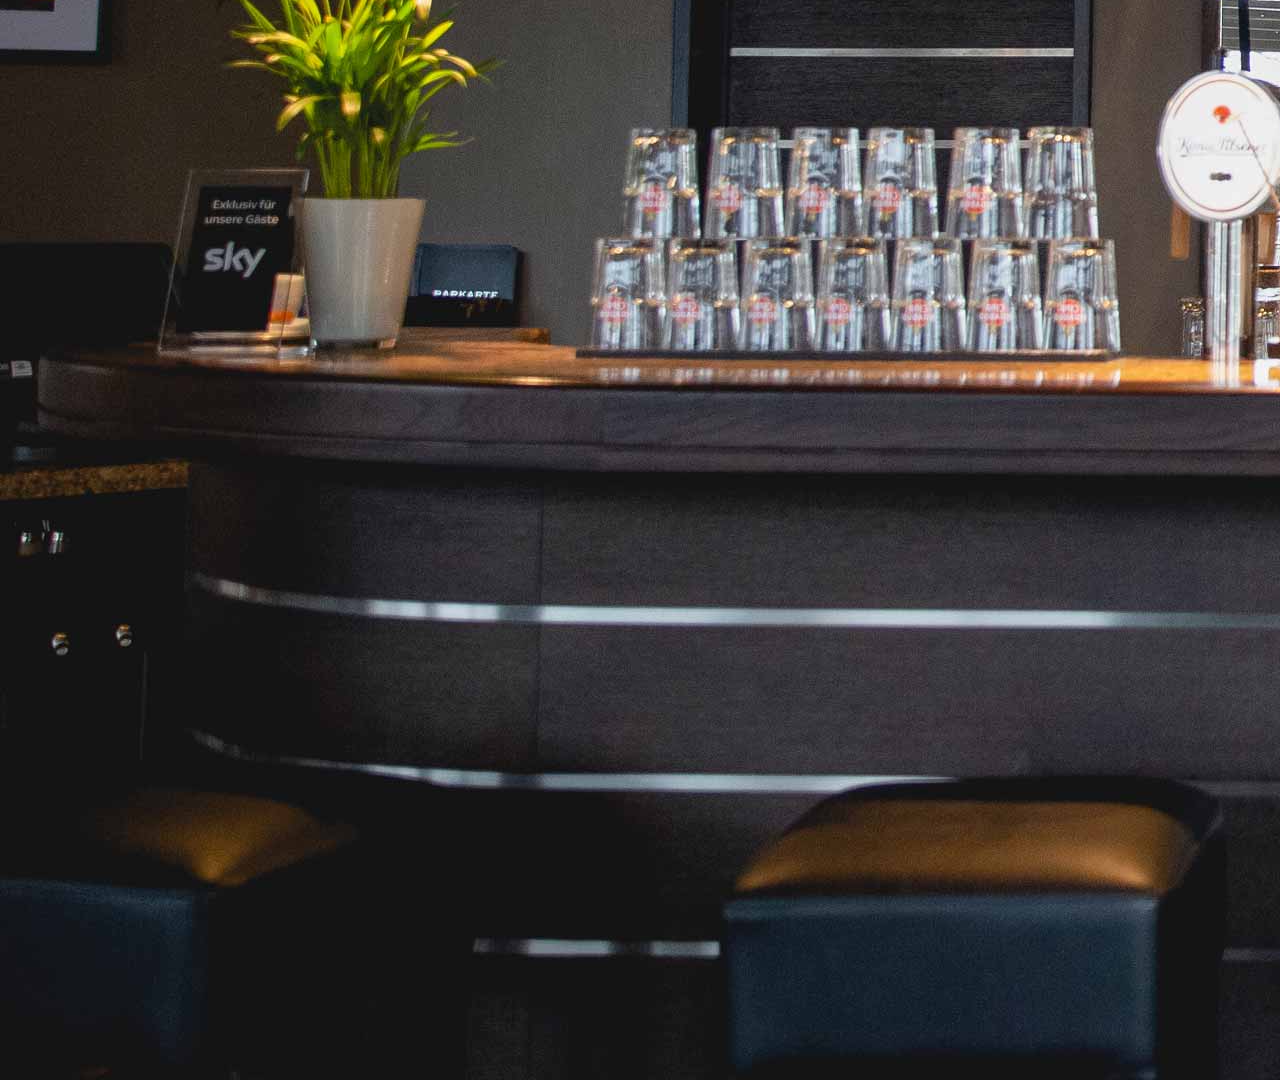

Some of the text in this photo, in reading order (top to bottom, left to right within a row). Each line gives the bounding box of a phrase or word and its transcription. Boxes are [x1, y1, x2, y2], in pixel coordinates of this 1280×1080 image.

[212, 199, 278, 210] Exklusiv für
[204, 213, 280, 225] unsere Gäste
[203, 240, 267, 278] sky
